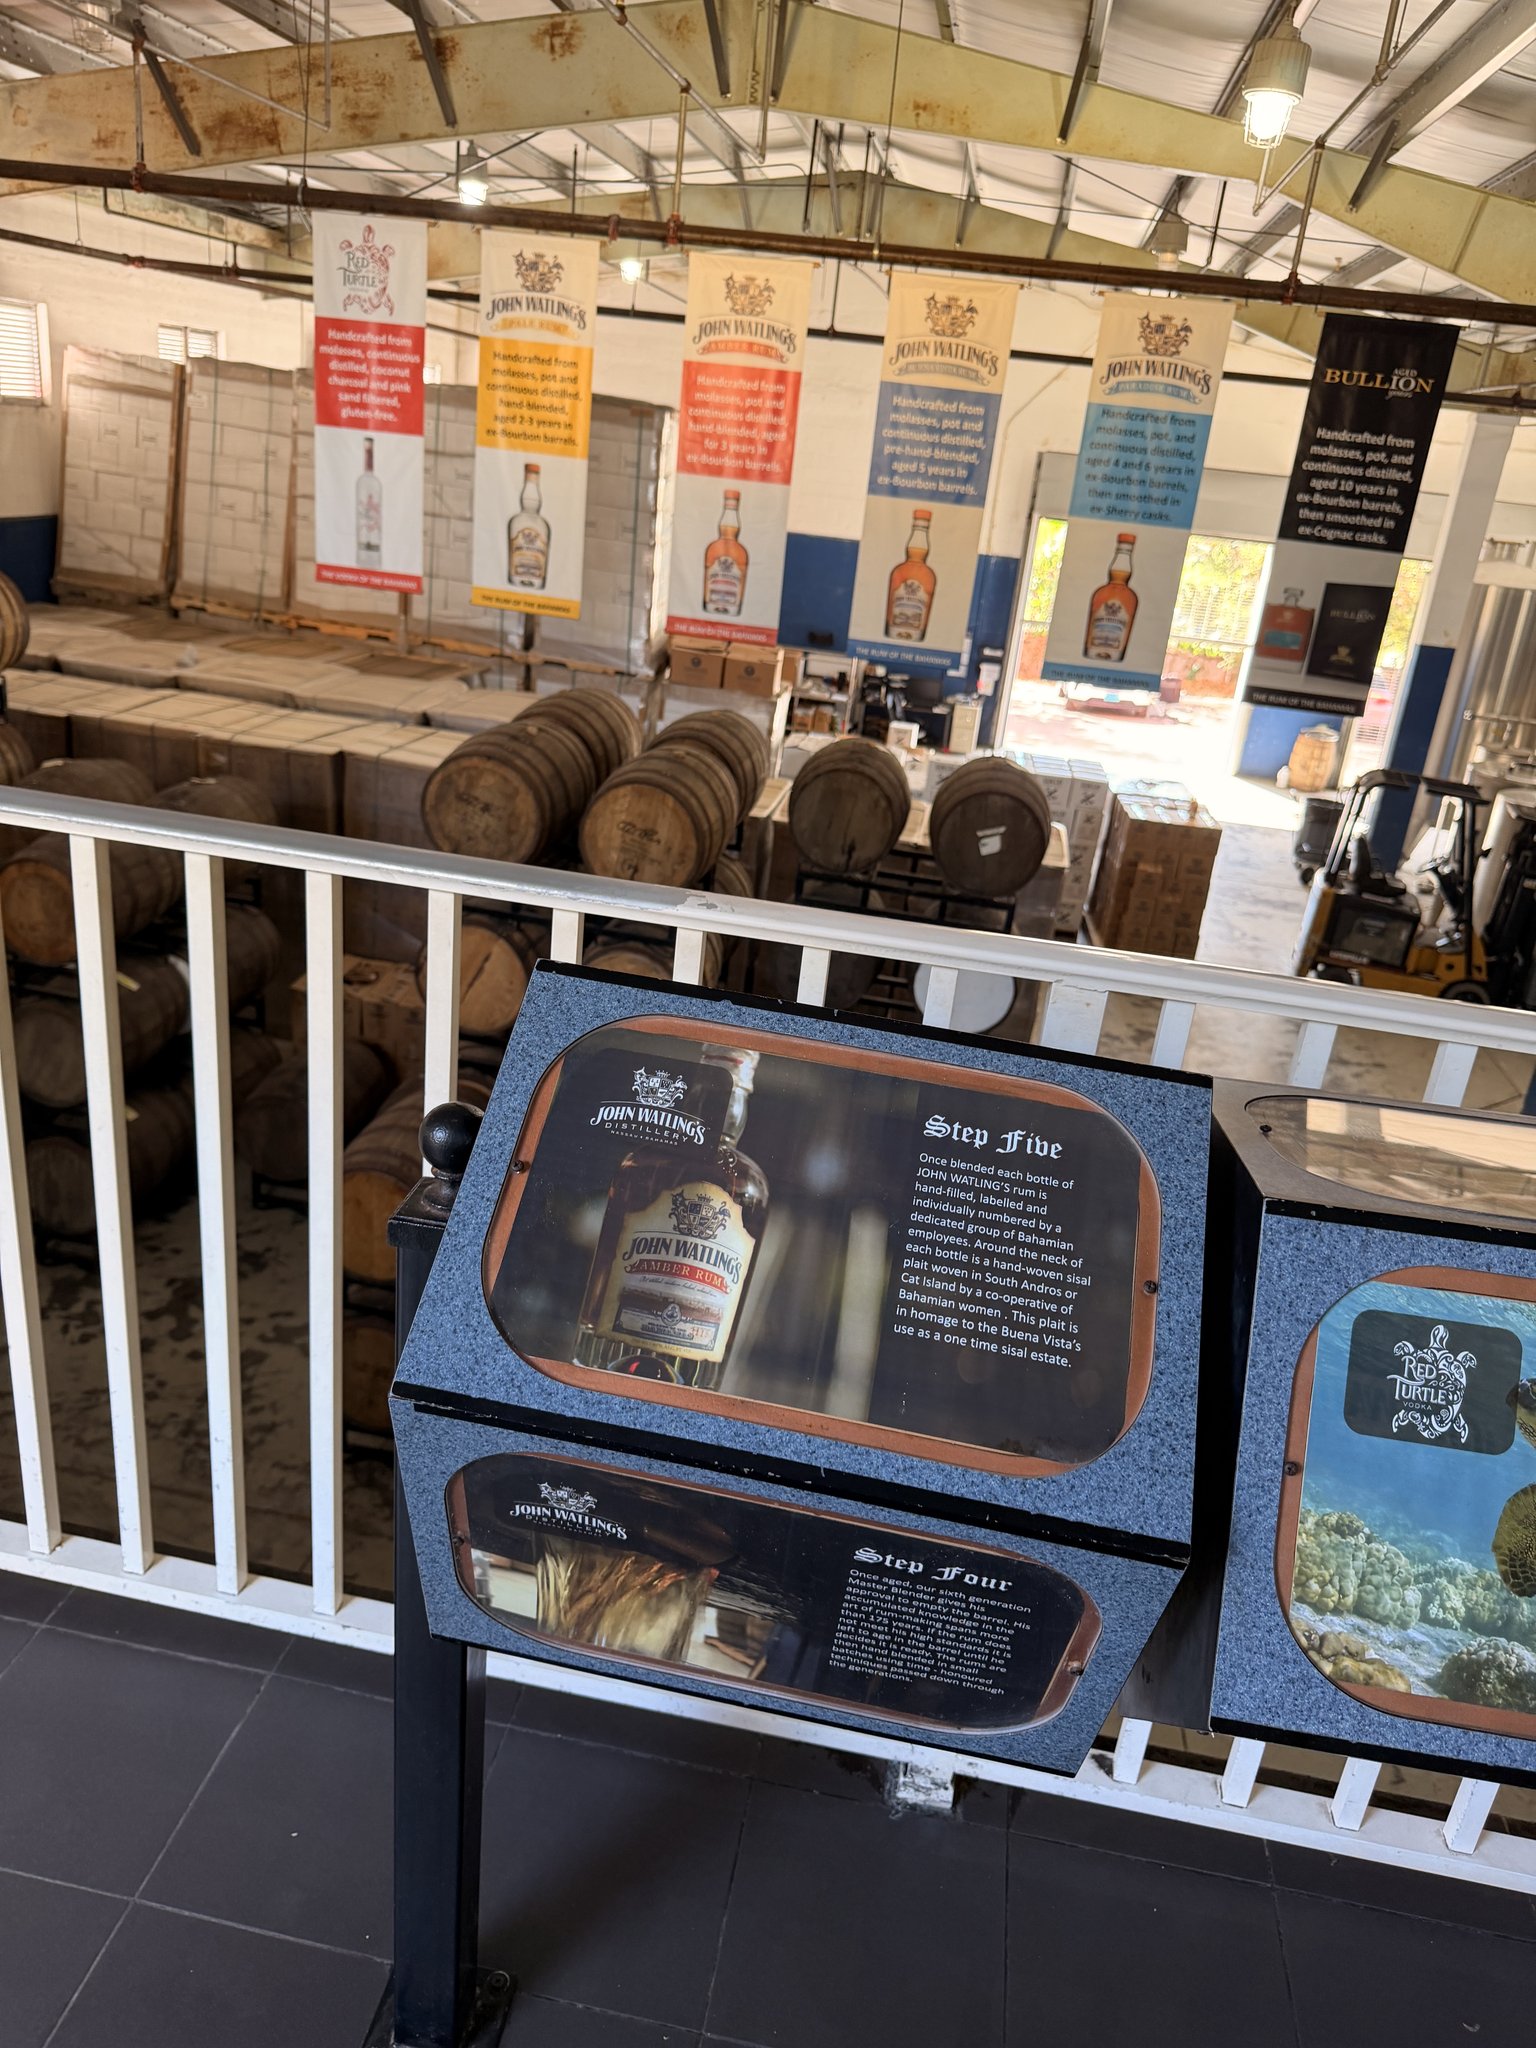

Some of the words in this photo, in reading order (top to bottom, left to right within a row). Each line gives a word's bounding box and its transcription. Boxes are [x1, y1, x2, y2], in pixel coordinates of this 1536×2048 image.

[336, 267, 378, 288] TURTLE
[345, 251, 370, 269] RED
[486, 296, 522, 321] JOHN
[526, 295, 587, 330] WATLING'S
[692, 320, 730, 344] JOHN
[734, 320, 796, 354] WATLING'S
[889, 341, 930, 365] JOHN
[934, 341, 999, 376] WATLING'S
[1099, 360, 1143, 385] JOHN
[1146, 360, 1212, 395] WATLING'S
[1324, 368, 1436, 393] BULLION
[1309, 443, 1364, 461] molasses,
[1364, 451, 1389, 464] pot,
[1390, 453, 1414, 465] and
[1315, 426, 1386, 445] Handcrafted
[1385, 433, 1415, 448] from
[1301, 460, 1364, 476] continuous
[1364, 465, 1413, 483] distilled,
[1309, 477, 1338, 490] aged
[1338, 479, 1354, 491] 10
[1354, 483, 1385, 495] years
[1385, 484, 1398, 497] in
[1295, 492, 1361, 508] ex-Bourbon
[1361, 497, 1404, 515] barrels,
[1298, 507, 1324, 520] then
[1324, 512, 1383, 527] smoothed
[1382, 516, 1395, 529] in
[1297, 525, 1354, 540] ex-Cognac
[1354, 531, 1387, 544] casks.
[590, 1106, 636, 1126] JOHN
[638, 1107, 706, 1145] WATLING'S
[605, 1122, 689, 1143] DISTILLERY
[923, 1114, 988, 1149] Step
[995, 1129, 1063, 1159] Five
[915, 1166, 947, 1181] JOHN
[949, 1172, 1010, 1193] WATLING'S
[1012, 1186, 1035, 1198] rum
[1038, 1188, 1047, 1200] is
[918, 1152, 947, 1166] Once
[949, 1157, 995, 1175] blended
[996, 1168, 1023, 1180] each
[1025, 1171, 1059, 1187] bottle
[1061, 1179, 1074, 1189] of
[912, 1195, 976, 1218] individually
[977, 1210, 1036, 1228] numbered
[1038, 1218, 1052, 1233] by
[1054, 1224, 1062, 1233] a
[914, 1180, 976, 1203] hand-filled,
[979, 1192, 1023, 1210] labelled
[1025, 1203, 1047, 1215] and
[907, 1227, 971, 1247] employees.
[973, 1238, 1016, 1255] Around
[1018, 1246, 1038, 1260] the
[1040, 1253, 1068, 1266] neck
[1069, 1257, 1083, 1269] of
[909, 1210, 965, 1230] dedicated
[966, 1223, 1000, 1238] group
[1002, 1228, 1015, 1239] of
[1017, 1230, 1074, 1251] Bahamian
[622, 1237, 673, 1261] JOHN
[674, 1239, 742, 1285] WATLING'S
[640, 1260, 690, 1276] AMBER
[696, 1269, 721, 1286] RUM
[902, 1256, 928, 1271] plait
[930, 1263, 968, 1278] woven
[970, 1268, 982, 1281] in
[984, 1271, 1018, 1288] South
[1020, 1279, 1062, 1297] Andros
[1064, 1289, 1078, 1299] or
[905, 1242, 932, 1255] each
[934, 1245, 968, 1262] bottle
[970, 1252, 980, 1264] is
[982, 1257, 990, 1266] a
[992, 1256, 1063, 1281] hand-woven
[1065, 1272, 1091, 1286] sisal
[898, 1287, 955, 1309] Bahamian
[957, 1301, 1001, 1318] women
[1011, 1309, 1035, 1325] This
[1038, 1315, 1066, 1331] plait
[1068, 1320, 1078, 1333] is
[900, 1271, 920, 1285] Cat
[922, 1275, 956, 1292] Island
[958, 1282, 973, 1297] by
[974, 1288, 982, 1297] a
[984, 1290, 1057, 1312] co-operative
[1059, 1303, 1073, 1315] of
[893, 1323, 914, 1336] use
[916, 1328, 930, 1339] as
[932, 1331, 940, 1341] a
[943, 1333, 967, 1346] one
[970, 1336, 998, 1352] time
[1000, 1343, 1027, 1358] sisal
[1029, 1350, 1071, 1367] estate.
[895, 1303, 907, 1317] in
[909, 1306, 958, 1328] homage
[961, 1317, 974, 1330] to
[977, 1320, 998, 1335] the
[1000, 1324, 1039, 1343] Buena
[1042, 1333, 1081, 1352] Vista's
[1401, 1355, 1437, 1380] RED
[1387, 1374, 1447, 1405] TURTLE
[1403, 1401, 1432, 1410] VODKA
[510, 1504, 551, 1517] JOHN
[554, 1508, 627, 1540] WATLING'S
[853, 1547, 923, 1574] Step
[931, 1566, 1012, 1592] Four
[845, 1585, 895, 1601] approval
[897, 1596, 909, 1604] to
[911, 1600, 949, 1613] empty
[951, 1607, 970, 1617] the
[972, 1611, 1009, 1626] barrel.
[1013, 1620, 1030, 1630] His
[847, 1576, 888, 1591] Master
[890, 1586, 935, 1601] Blender
[936, 1597, 966, 1608] gives
[968, 1602, 985, 1612] his
[849, 1568, 879, 1580] Once
[881, 1576, 912, 1588] aged,
[915, 1584, 936, 1592] our
[938, 1588, 966, 1599] sixth
[967, 1595, 1031, 1613] generation
[843, 1593, 916, 1614] accumulated
[917, 1608, 979, 1627] knowledge
[981, 1622, 992, 1630] in
[995, 1625, 1014, 1634] the
